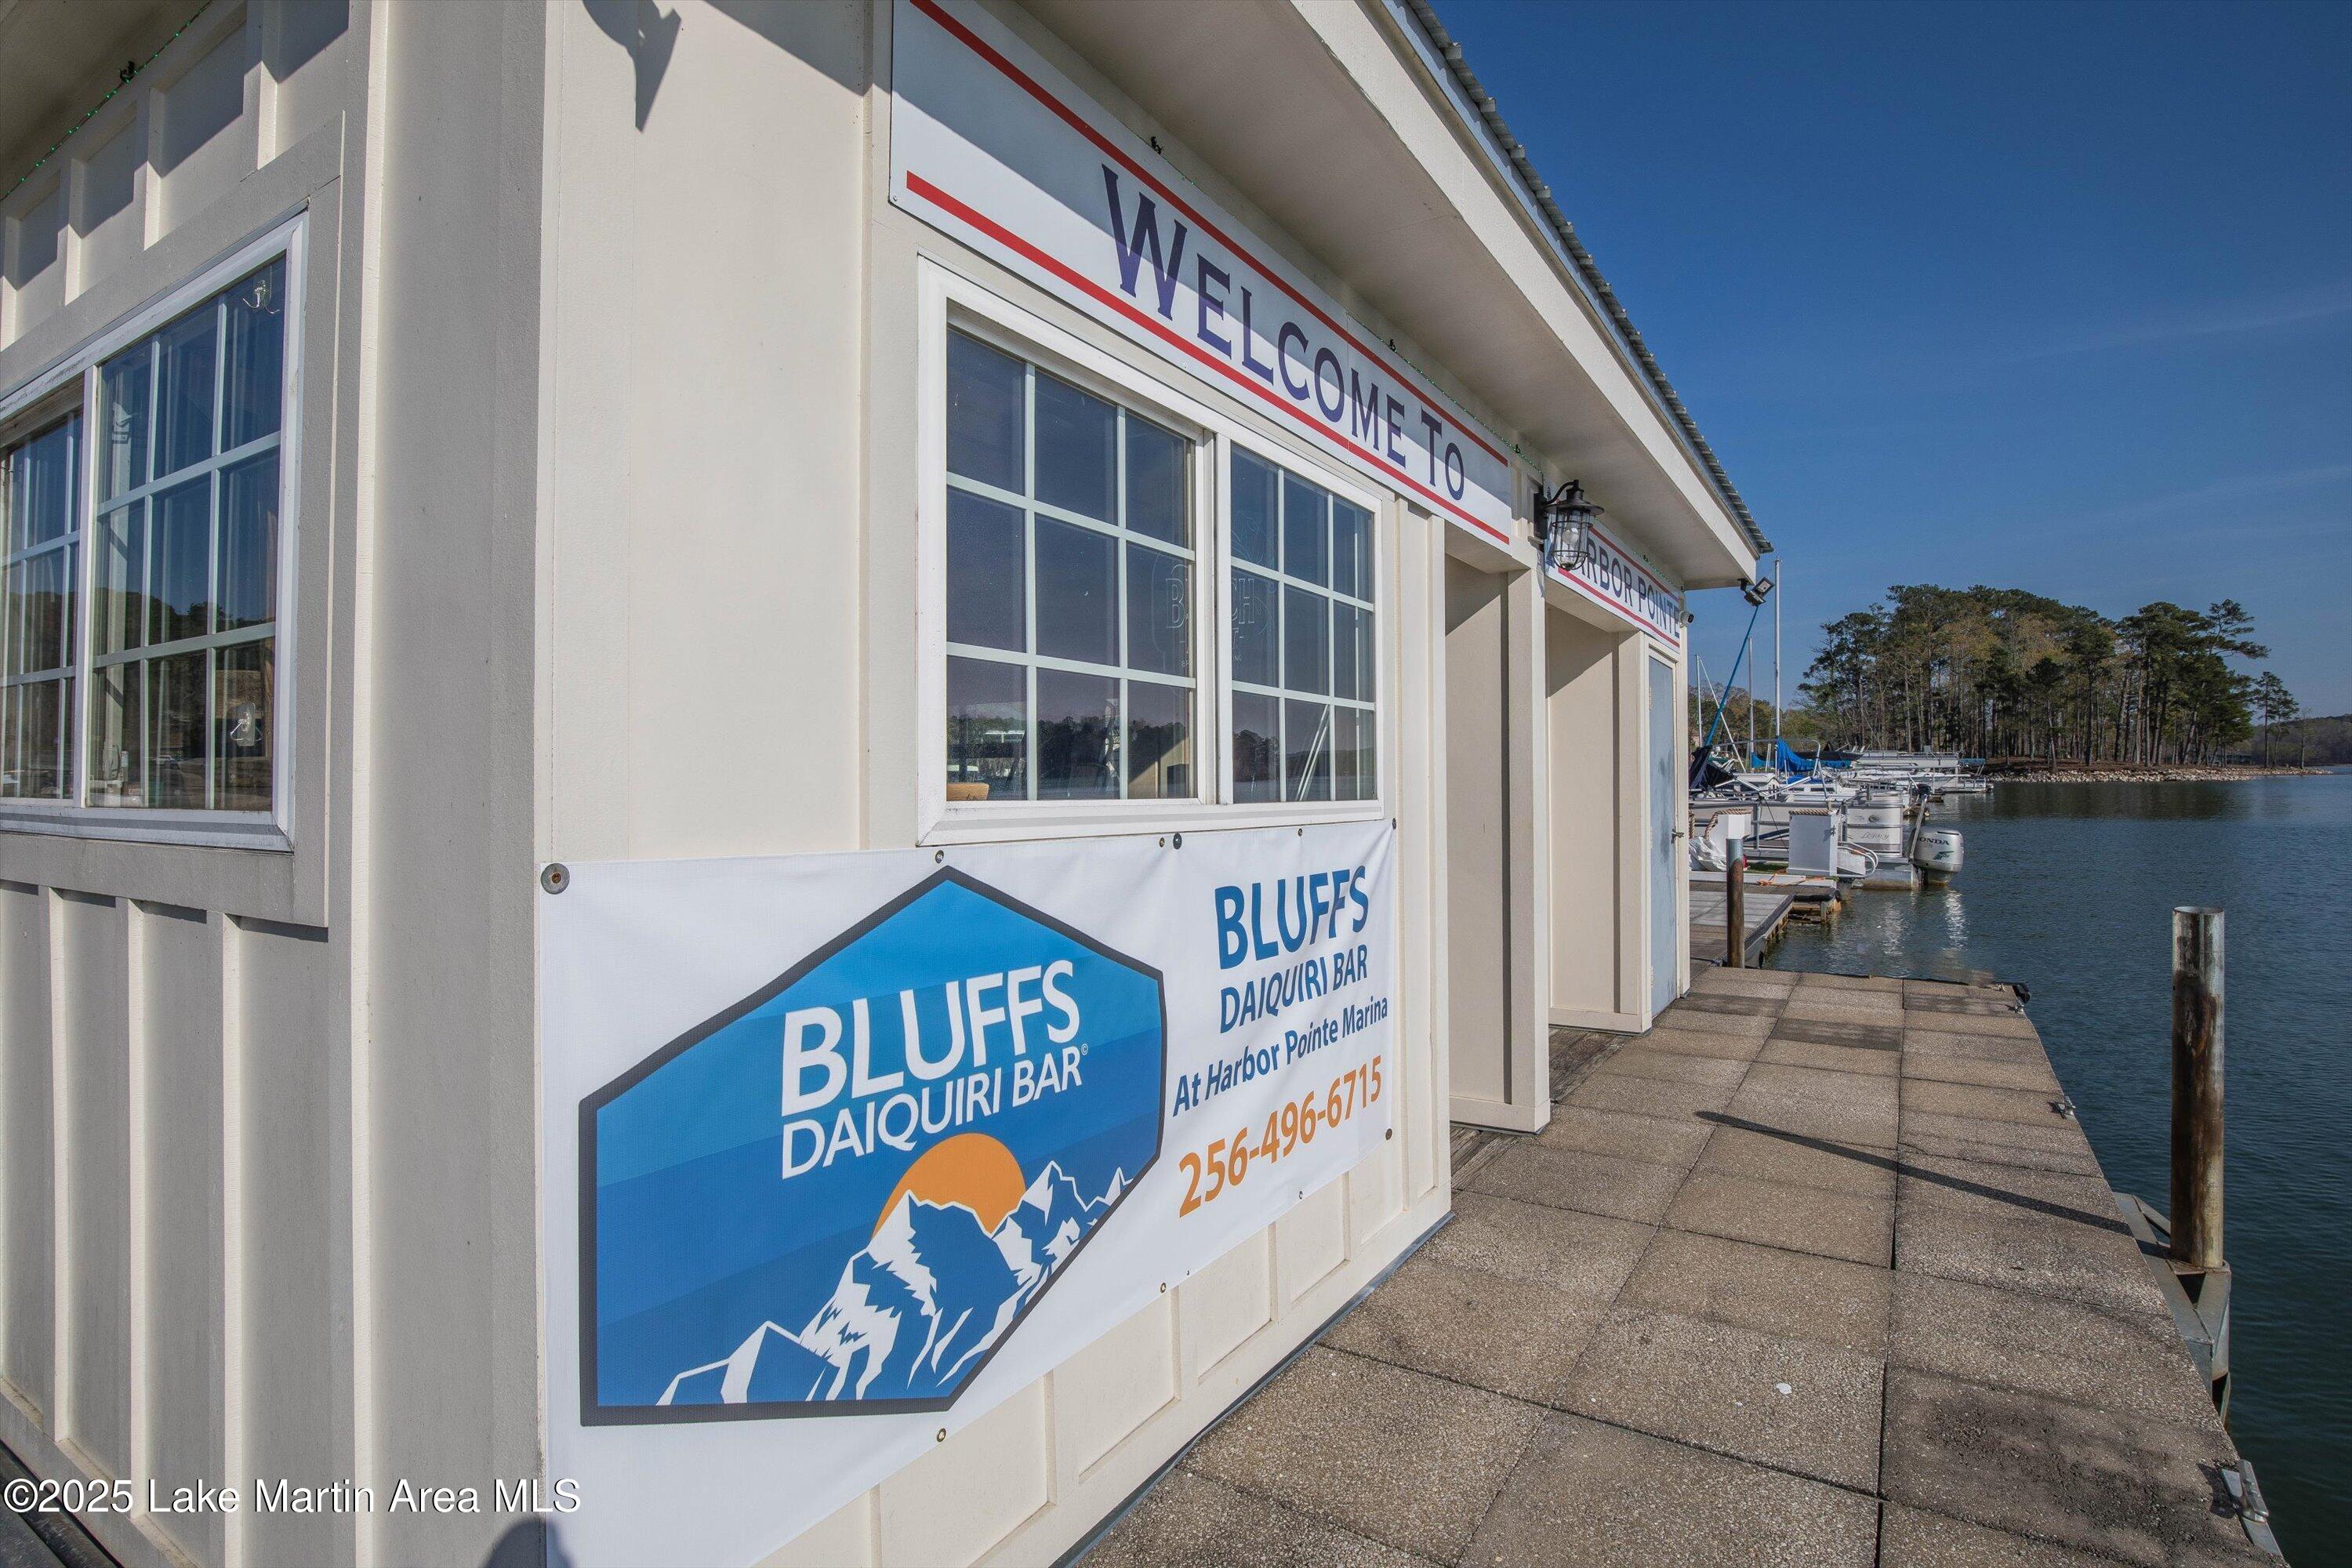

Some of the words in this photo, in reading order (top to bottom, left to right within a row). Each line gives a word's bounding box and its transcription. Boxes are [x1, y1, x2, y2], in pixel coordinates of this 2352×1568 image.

[1102, 163, 1406, 469] WELCOME
[1421, 407, 1465, 501] TO
[1577, 535, 1633, 608] RBOR
[1918, 837, 1950, 845] ONDA
[1214, 865, 1369, 970] BLUFFS
[782, 960, 1080, 1116] BLUFFS
[1220, 956, 1328, 1033] DAIQUIRI
[1333, 944, 1367, 991] BAR
[1172, 1074, 1201, 1117] At
[1205, 1043, 1279, 1101] Harbor
[1286, 1018, 1338, 1066] Pointe
[1342, 995, 1388, 1039] Marina
[782, 1067, 1002, 1180] DAIQUIRI
[1179, 1054, 1381, 1218] 256-496-6715
